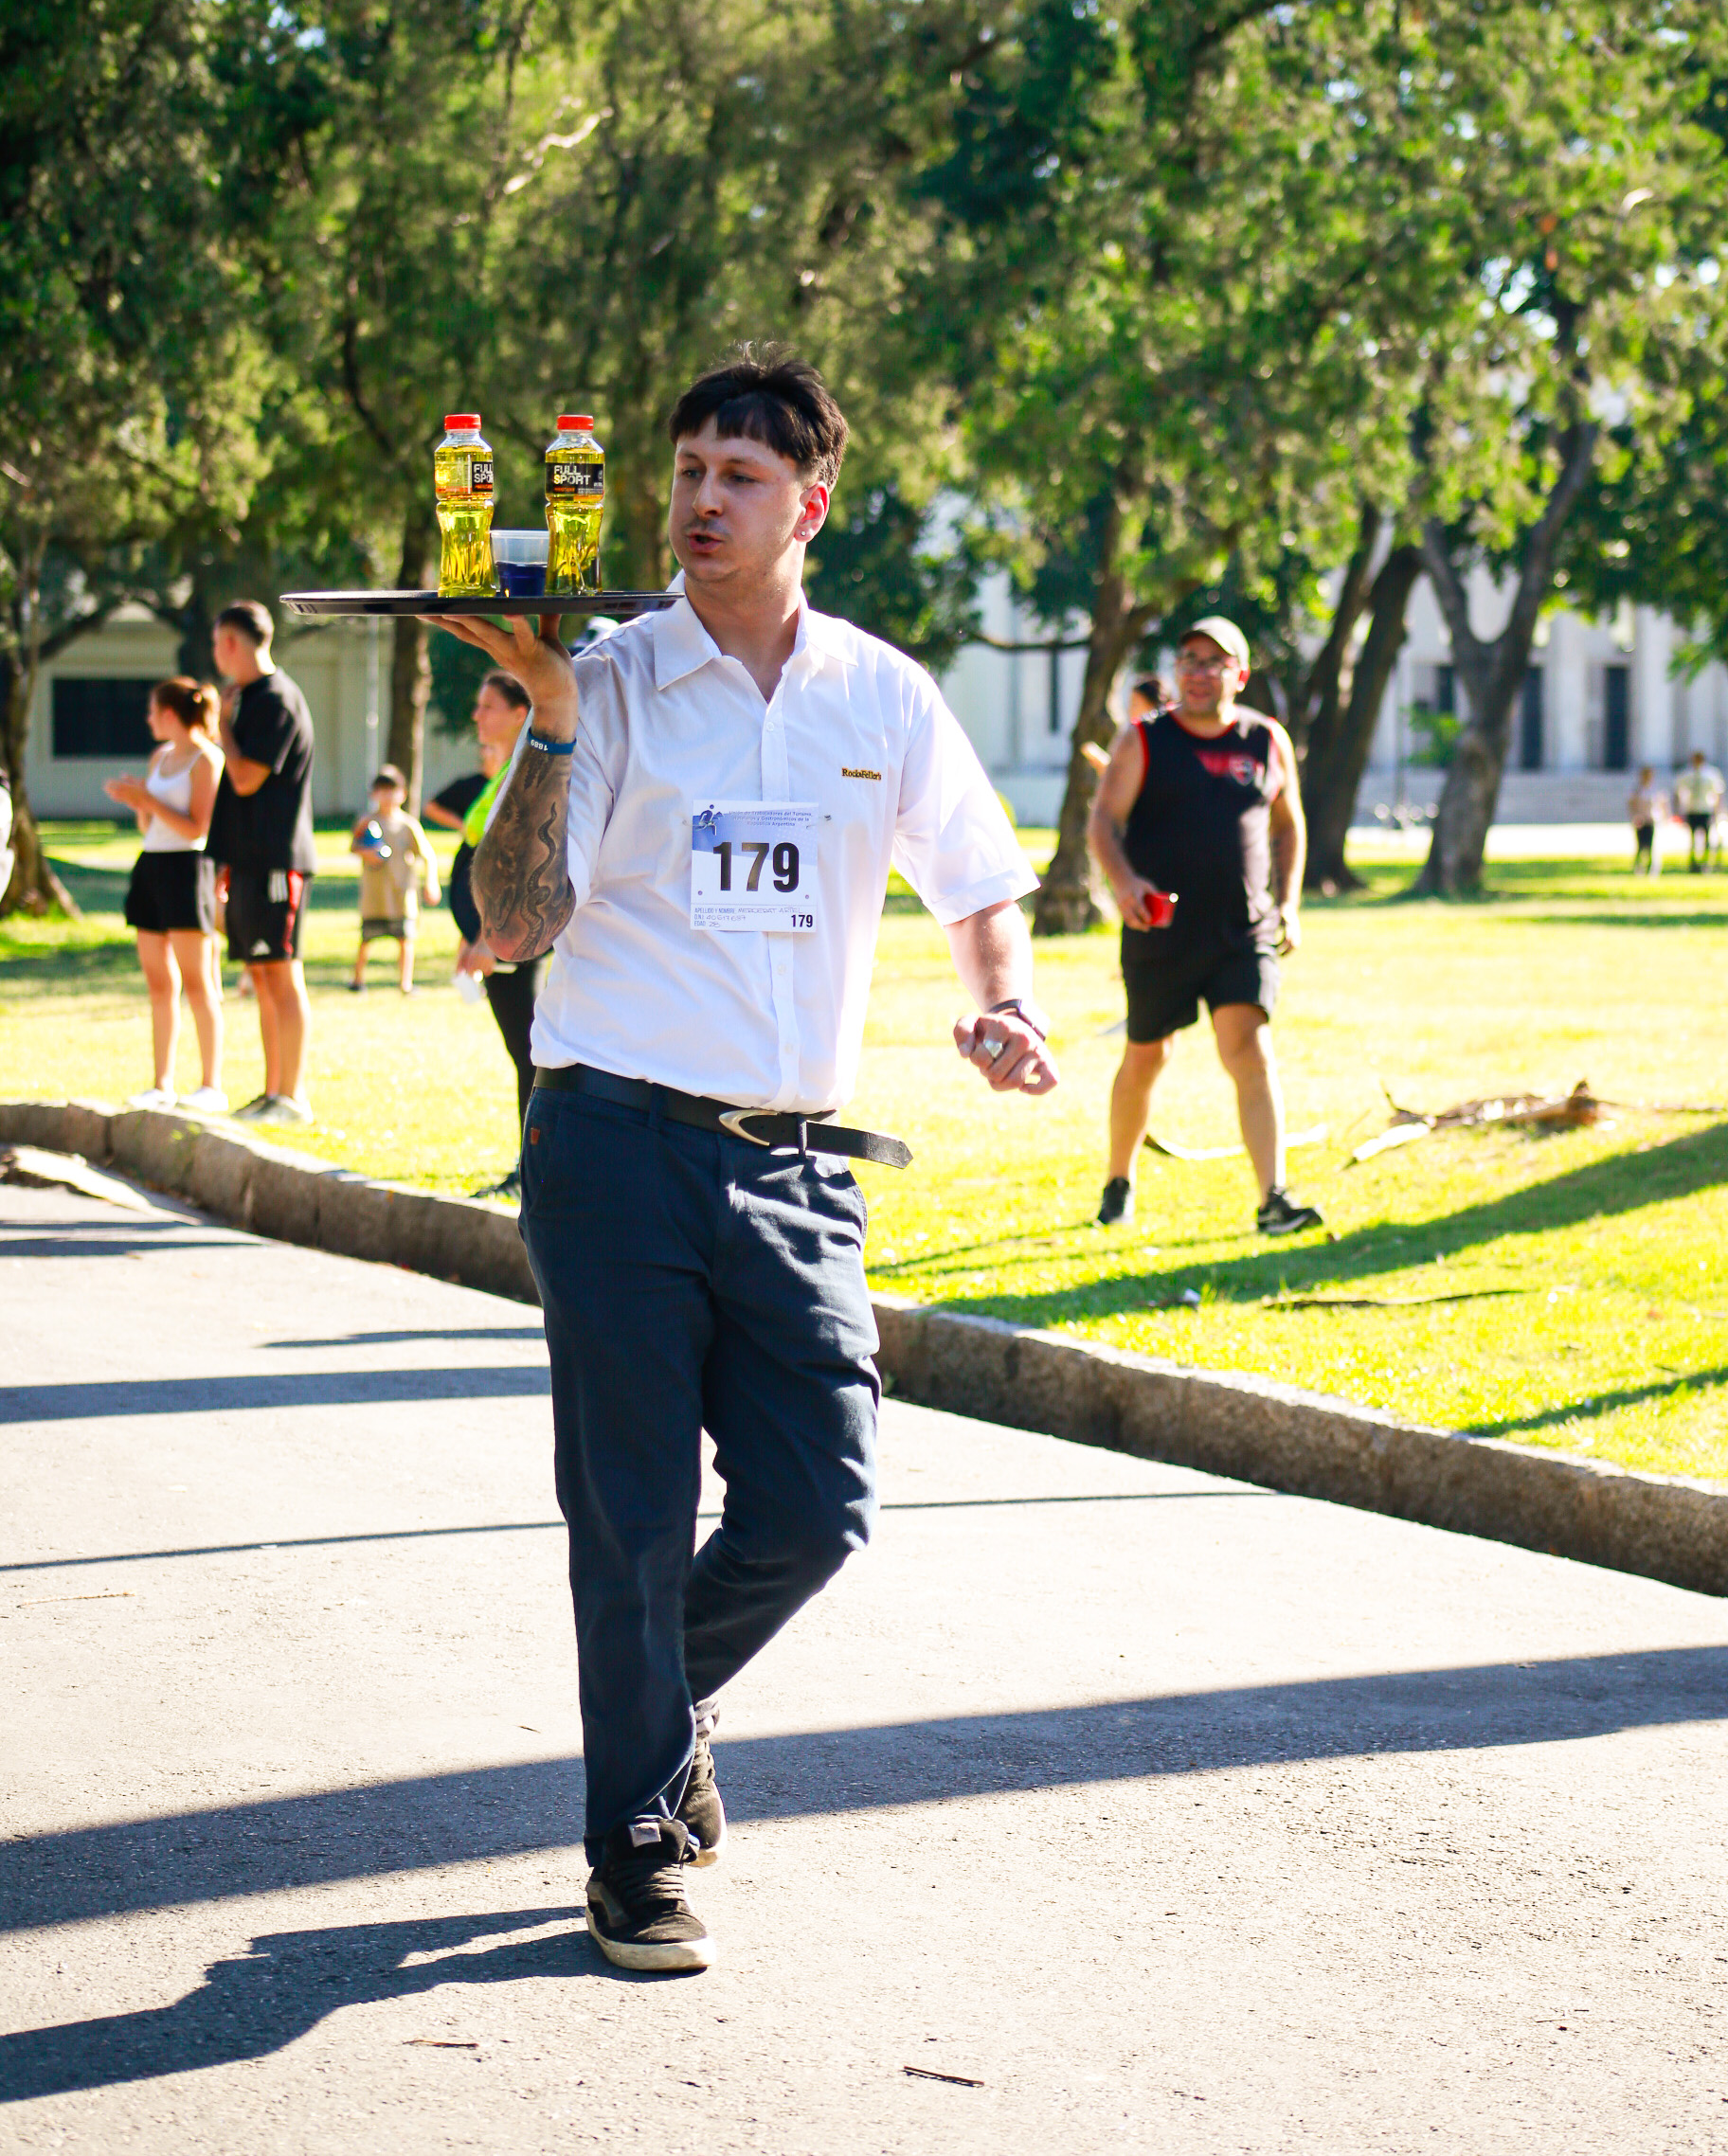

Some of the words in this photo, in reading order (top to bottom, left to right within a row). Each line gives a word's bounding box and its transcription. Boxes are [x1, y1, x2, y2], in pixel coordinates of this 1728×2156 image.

[554, 465, 581, 475] FULL
[554, 475, 590, 485] SPORT
[712, 842, 800, 893] 179
[791, 914, 814, 928] 179
